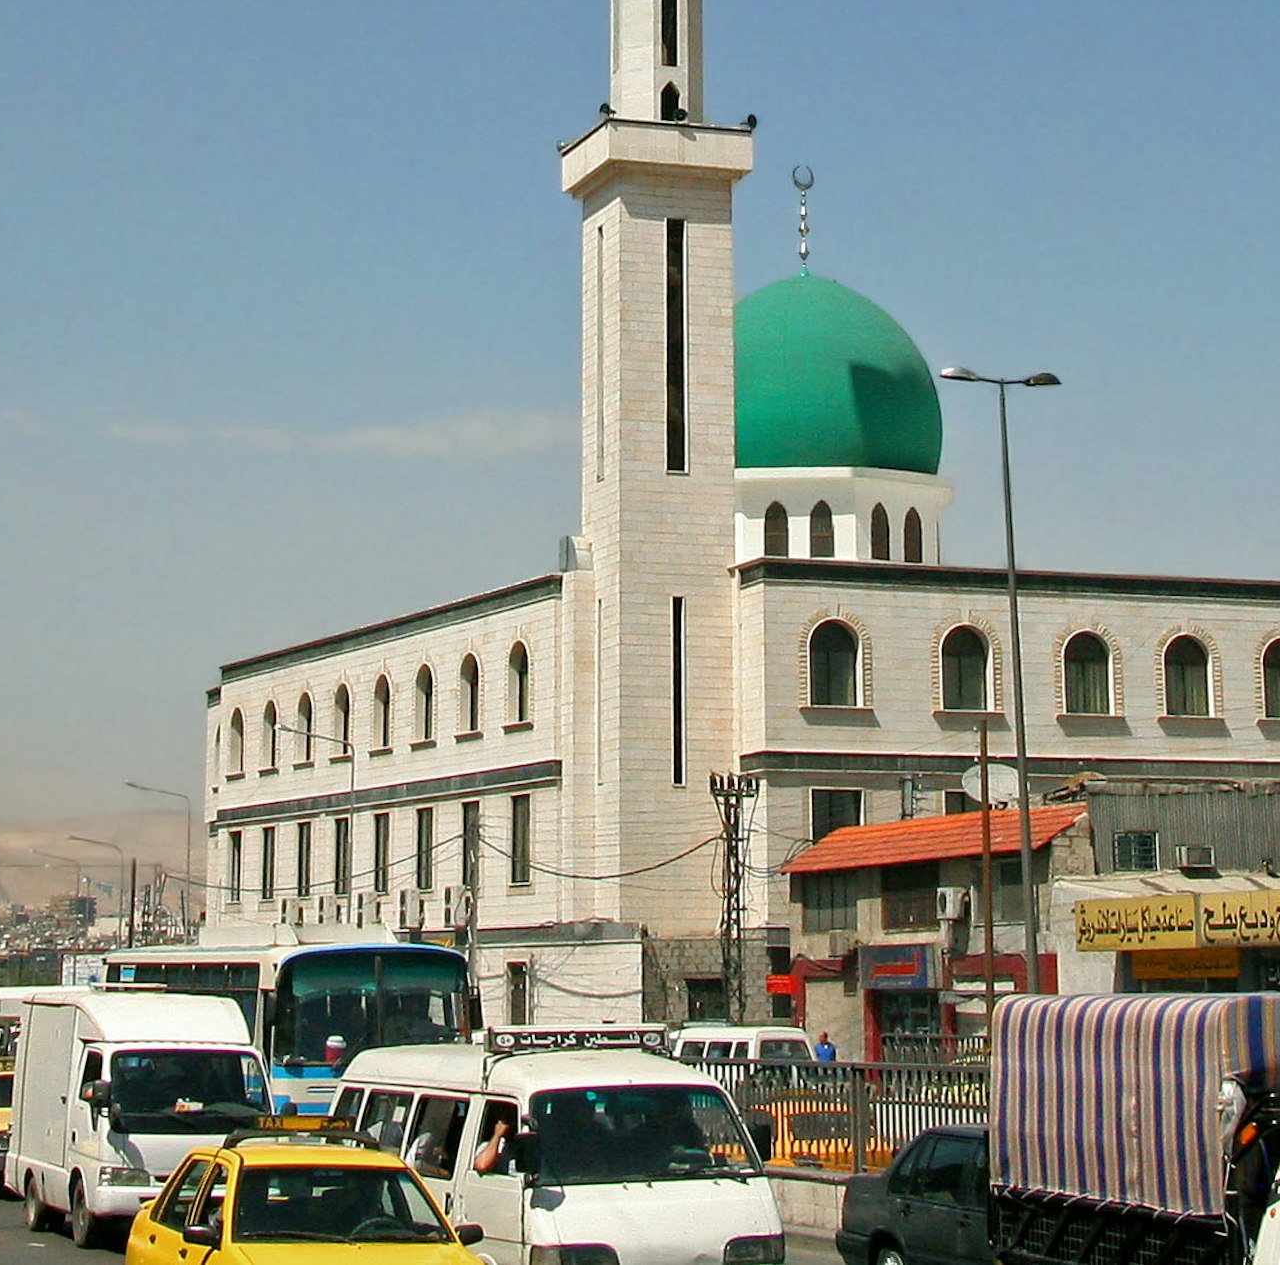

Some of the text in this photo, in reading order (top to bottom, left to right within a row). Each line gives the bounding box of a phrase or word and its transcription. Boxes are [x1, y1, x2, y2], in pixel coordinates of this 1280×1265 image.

[1239, 905, 1275, 942] وديع
[520, 1031, 577, 1050] كراجات
[584, 1031, 640, 1048] فلسطين
